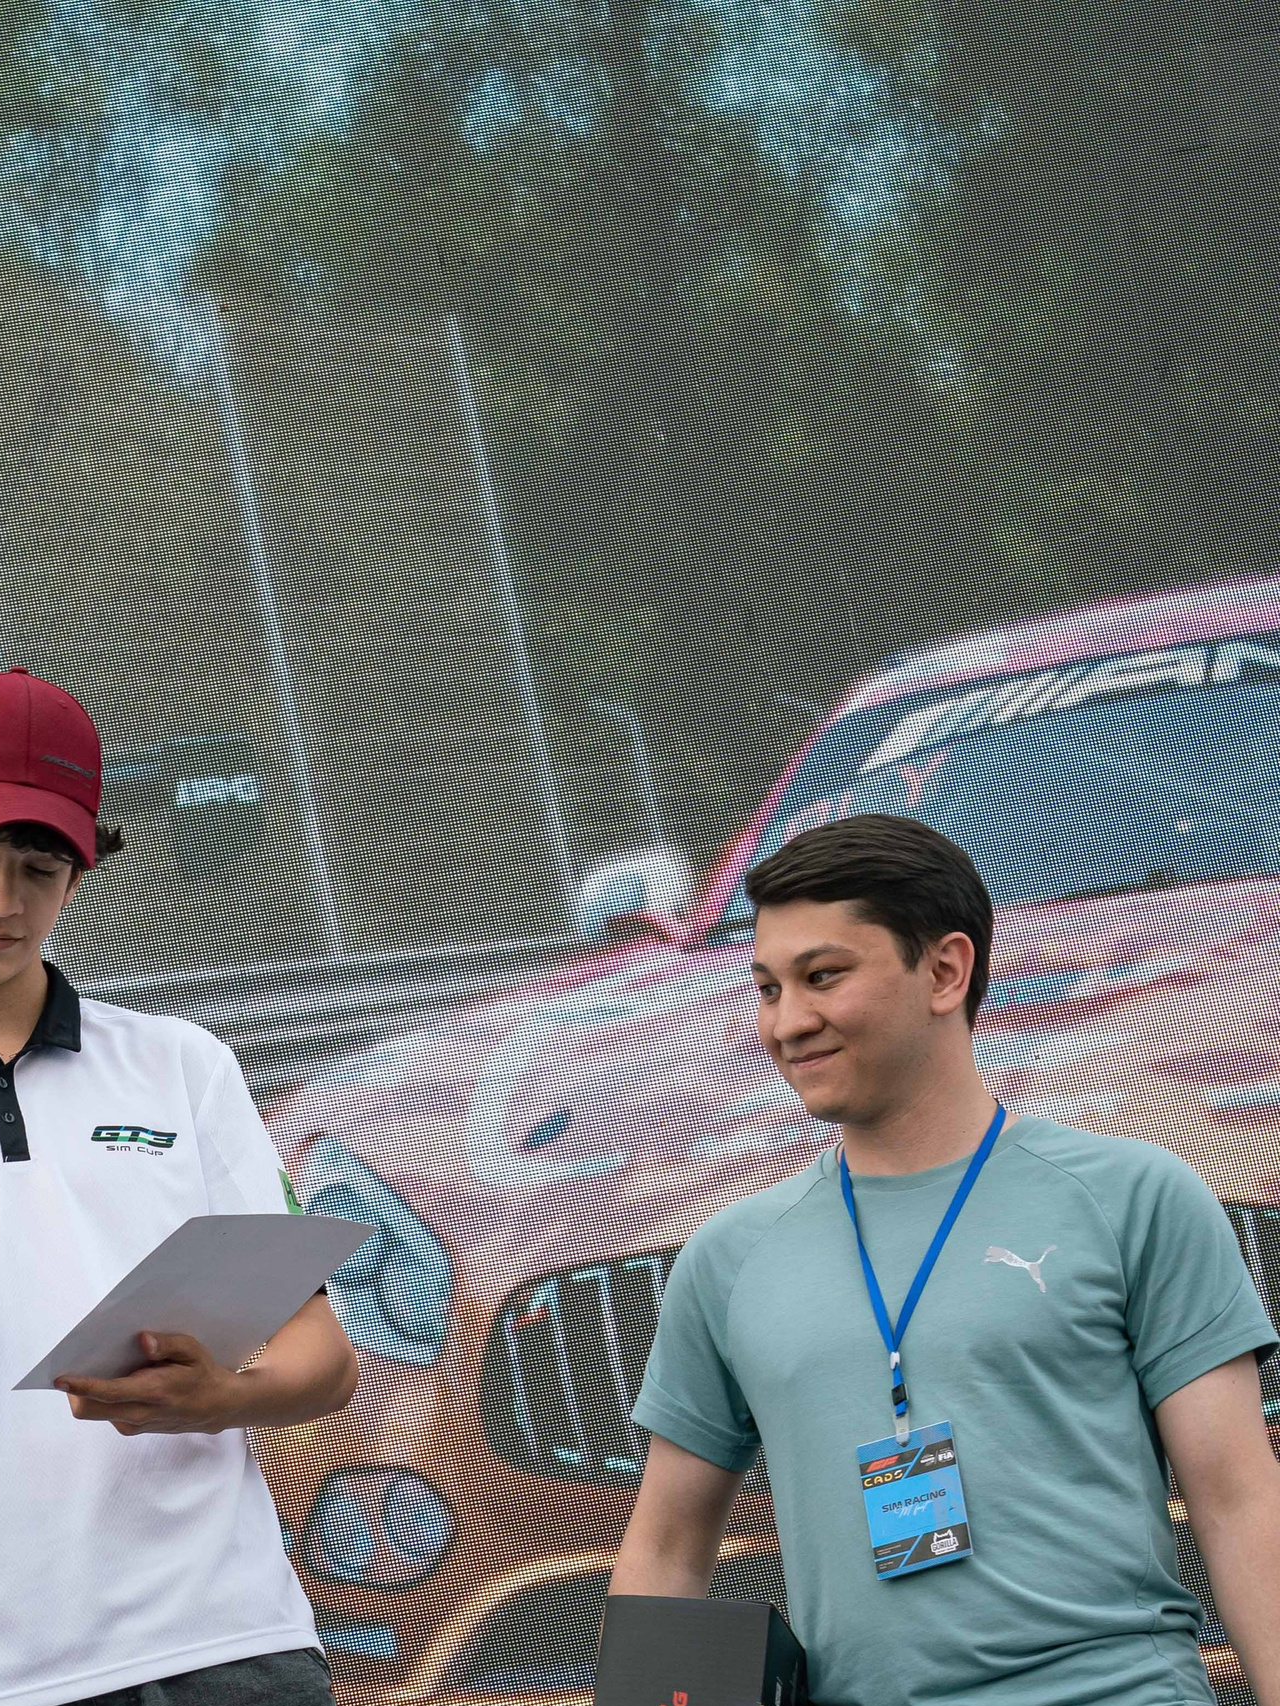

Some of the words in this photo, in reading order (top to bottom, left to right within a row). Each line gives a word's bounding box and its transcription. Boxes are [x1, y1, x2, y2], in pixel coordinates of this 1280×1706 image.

[90, 1125, 178, 1149] GT3
[137, 1146, 164, 1156] CUP
[881, 1501, 903, 1513] SIM
[904, 1488, 947, 1507] RACING
[931, 1537, 958, 1552] GORILLA
